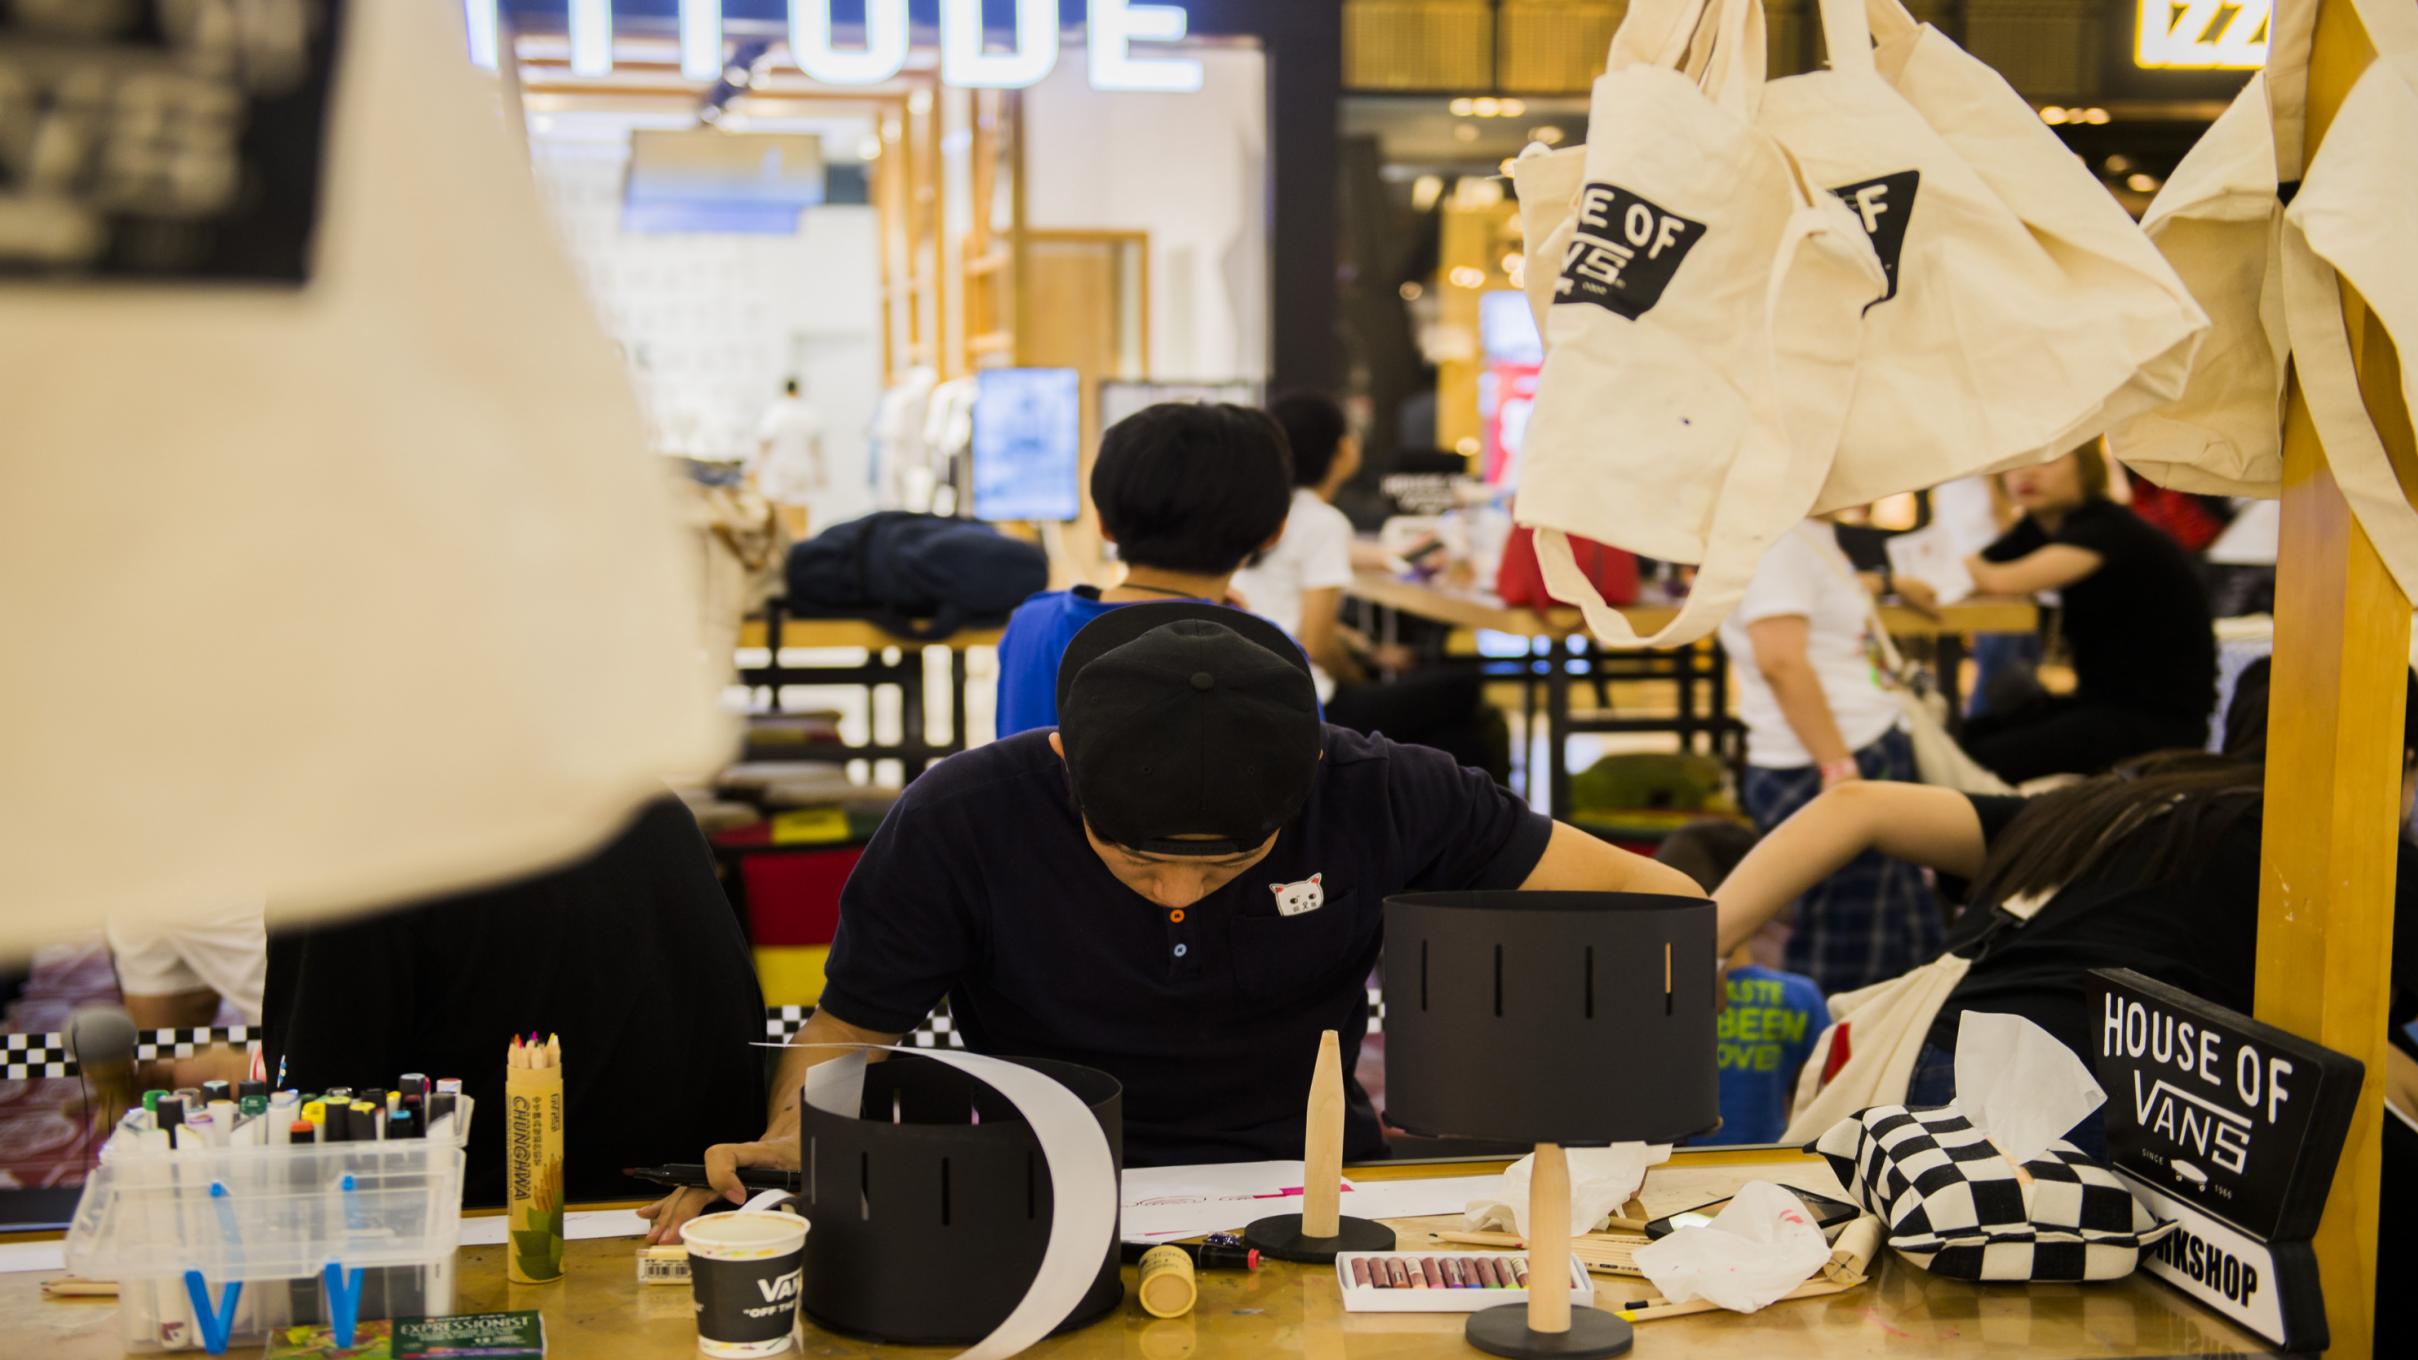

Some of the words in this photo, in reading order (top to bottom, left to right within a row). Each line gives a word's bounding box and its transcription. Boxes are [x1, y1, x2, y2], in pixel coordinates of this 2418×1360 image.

[1624, 203, 1686, 260] OF
[2103, 991, 2221, 1085] HOUSE
[2236, 1044, 2293, 1125] OF
[512, 1095, 531, 1201] CHUNGHWA
[2133, 1068, 2253, 1175] VANS
[2141, 1147, 2165, 1166] SINCE
[400, 1315, 529, 1335] EXPRESSIONIST
